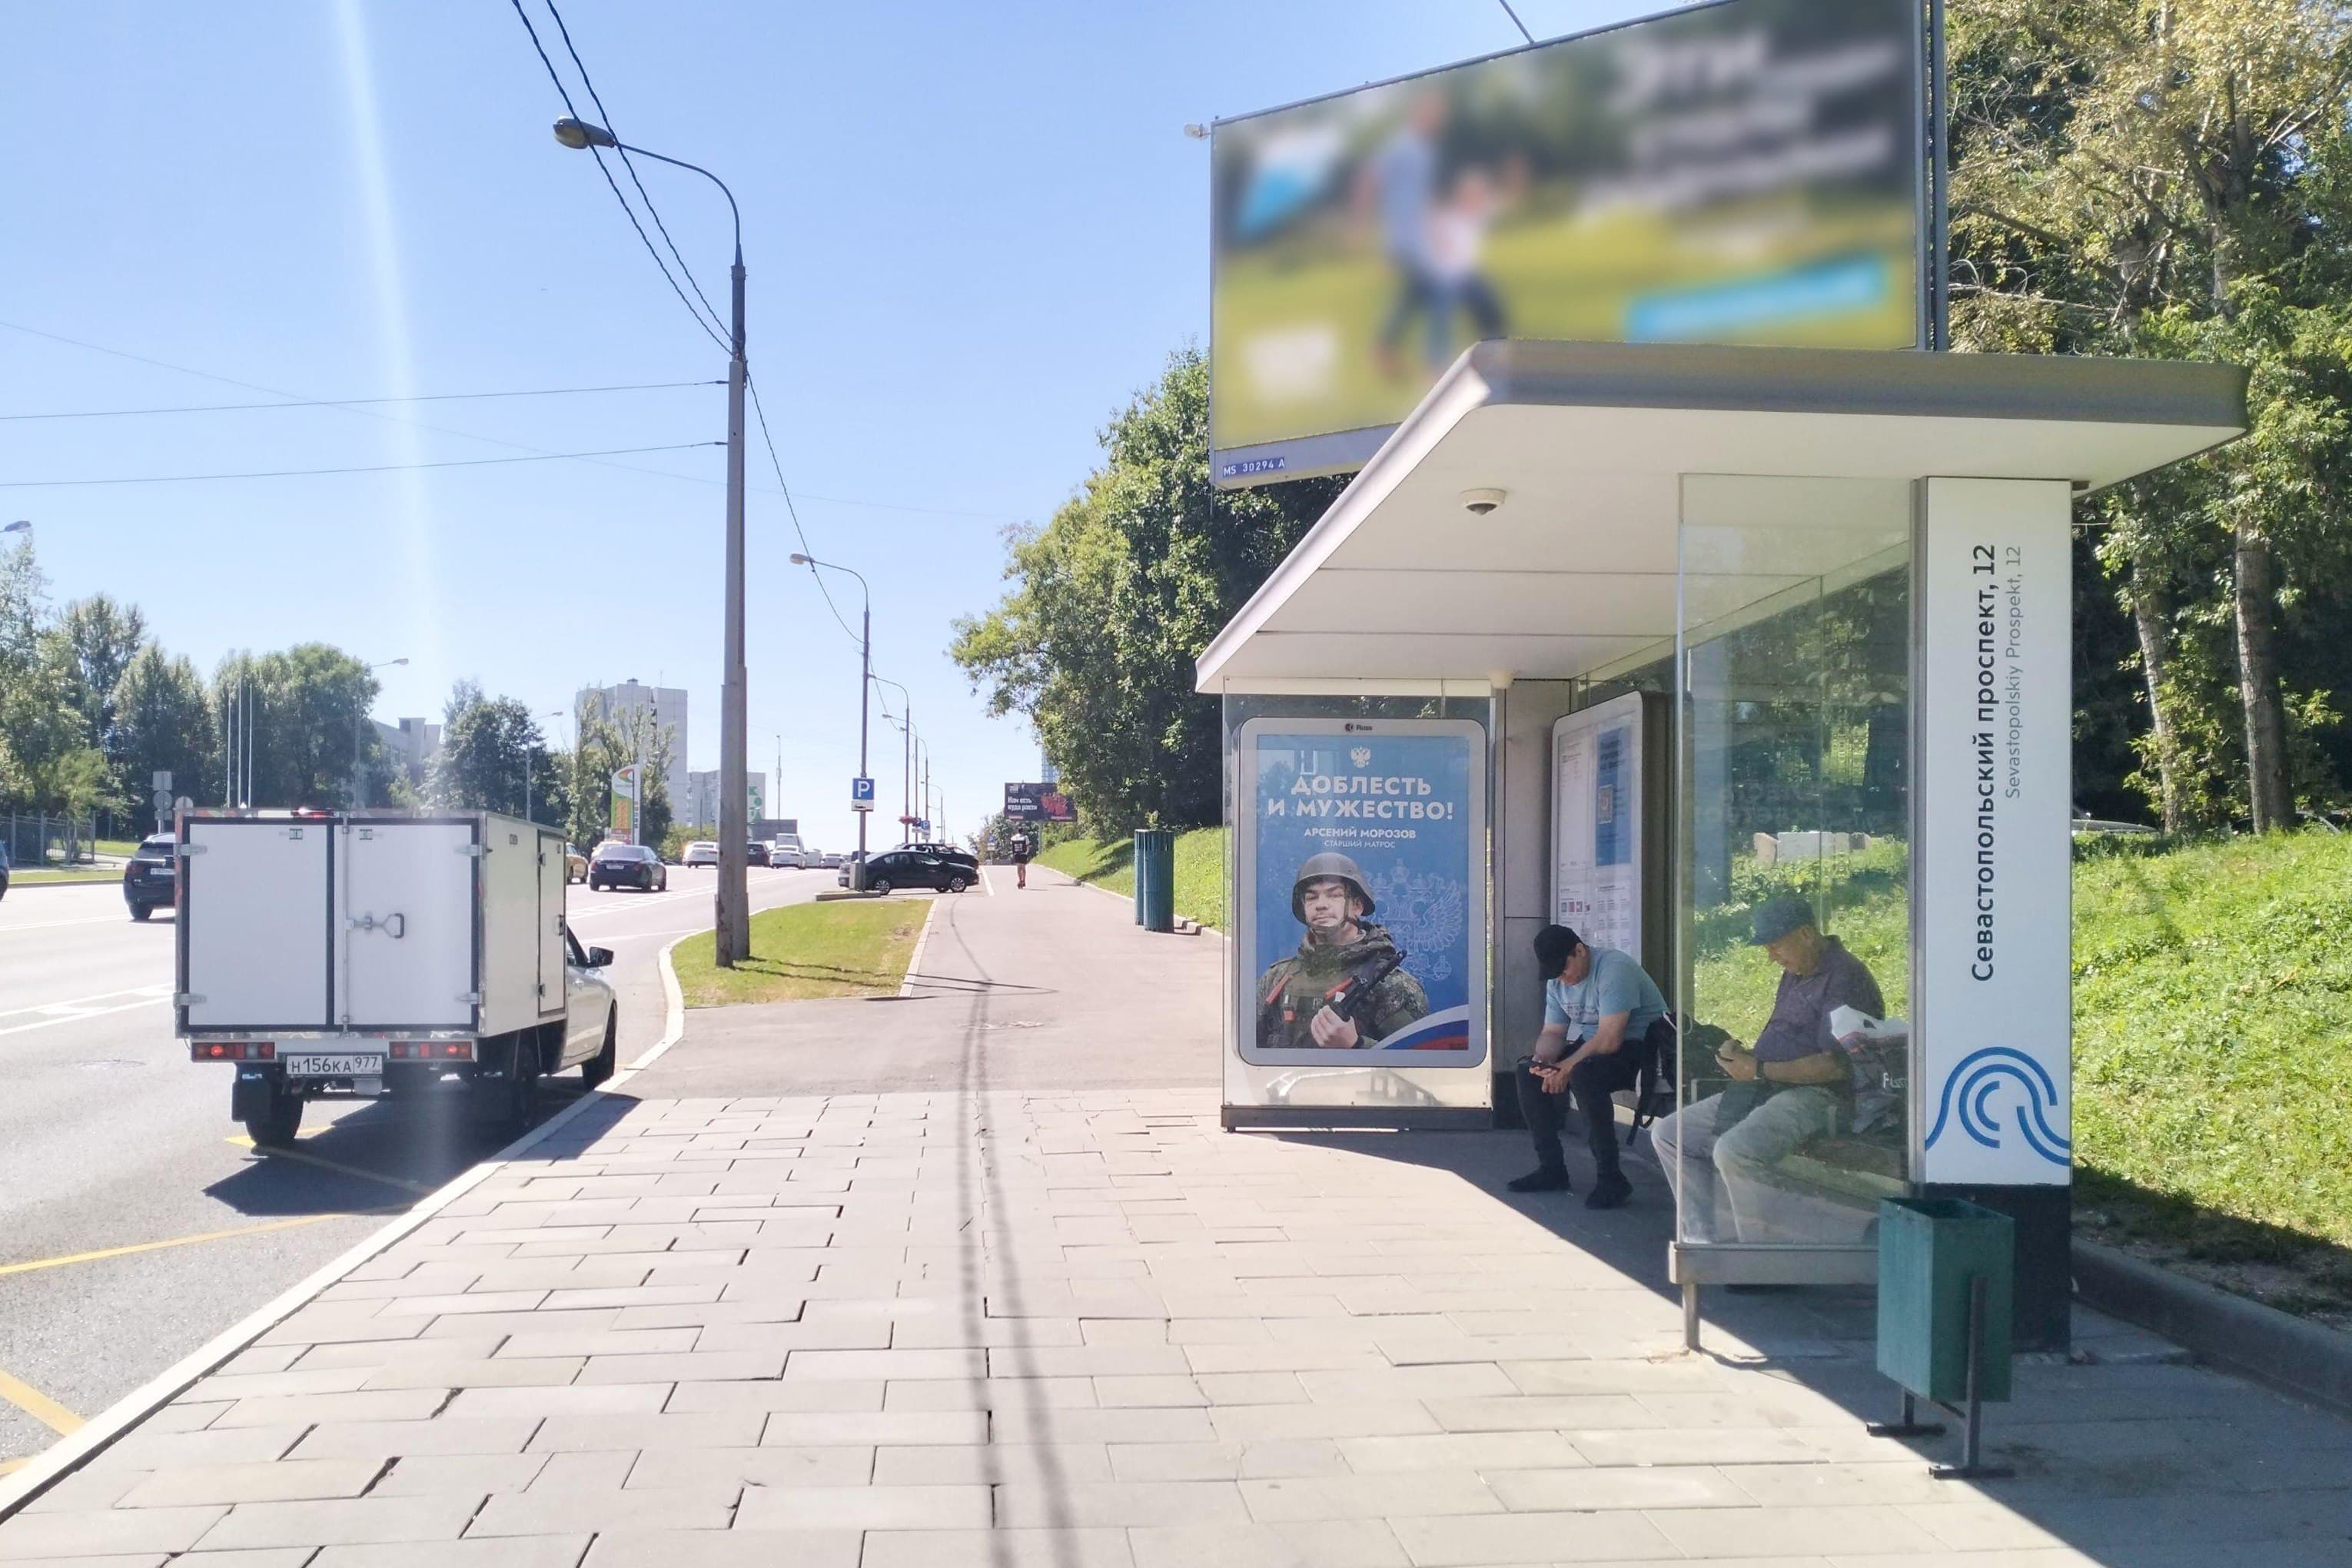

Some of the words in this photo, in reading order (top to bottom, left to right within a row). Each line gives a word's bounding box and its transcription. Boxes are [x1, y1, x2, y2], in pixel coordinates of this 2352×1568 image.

[1224, 465, 1237, 477] MS
[1242, 460, 1274, 473] 30294
[1278, 458, 1285, 467] A
[1973, 544, 1995, 575] 12
[2005, 546, 2021, 566] 12
[2005, 574, 2024, 658] Prospekt,
[1978, 584, 1999, 721] проспект,
[2005, 666, 2023, 799] Sevastopolskiy
[1291, 775, 1431, 796] ДОБЛЕСТЬ
[1268, 798, 1285, 816] И
[1296, 799, 1453, 820] МУЖЕСТВО!
[1304, 826, 1357, 838] АРСЕНИЙ
[1360, 829, 1416, 839] МОРОЗОВ
[1324, 839, 1363, 849] СТАРШИЙ
[1972, 733, 1994, 981] Севастопольский
[354, 1056, 378, 1068] 977
